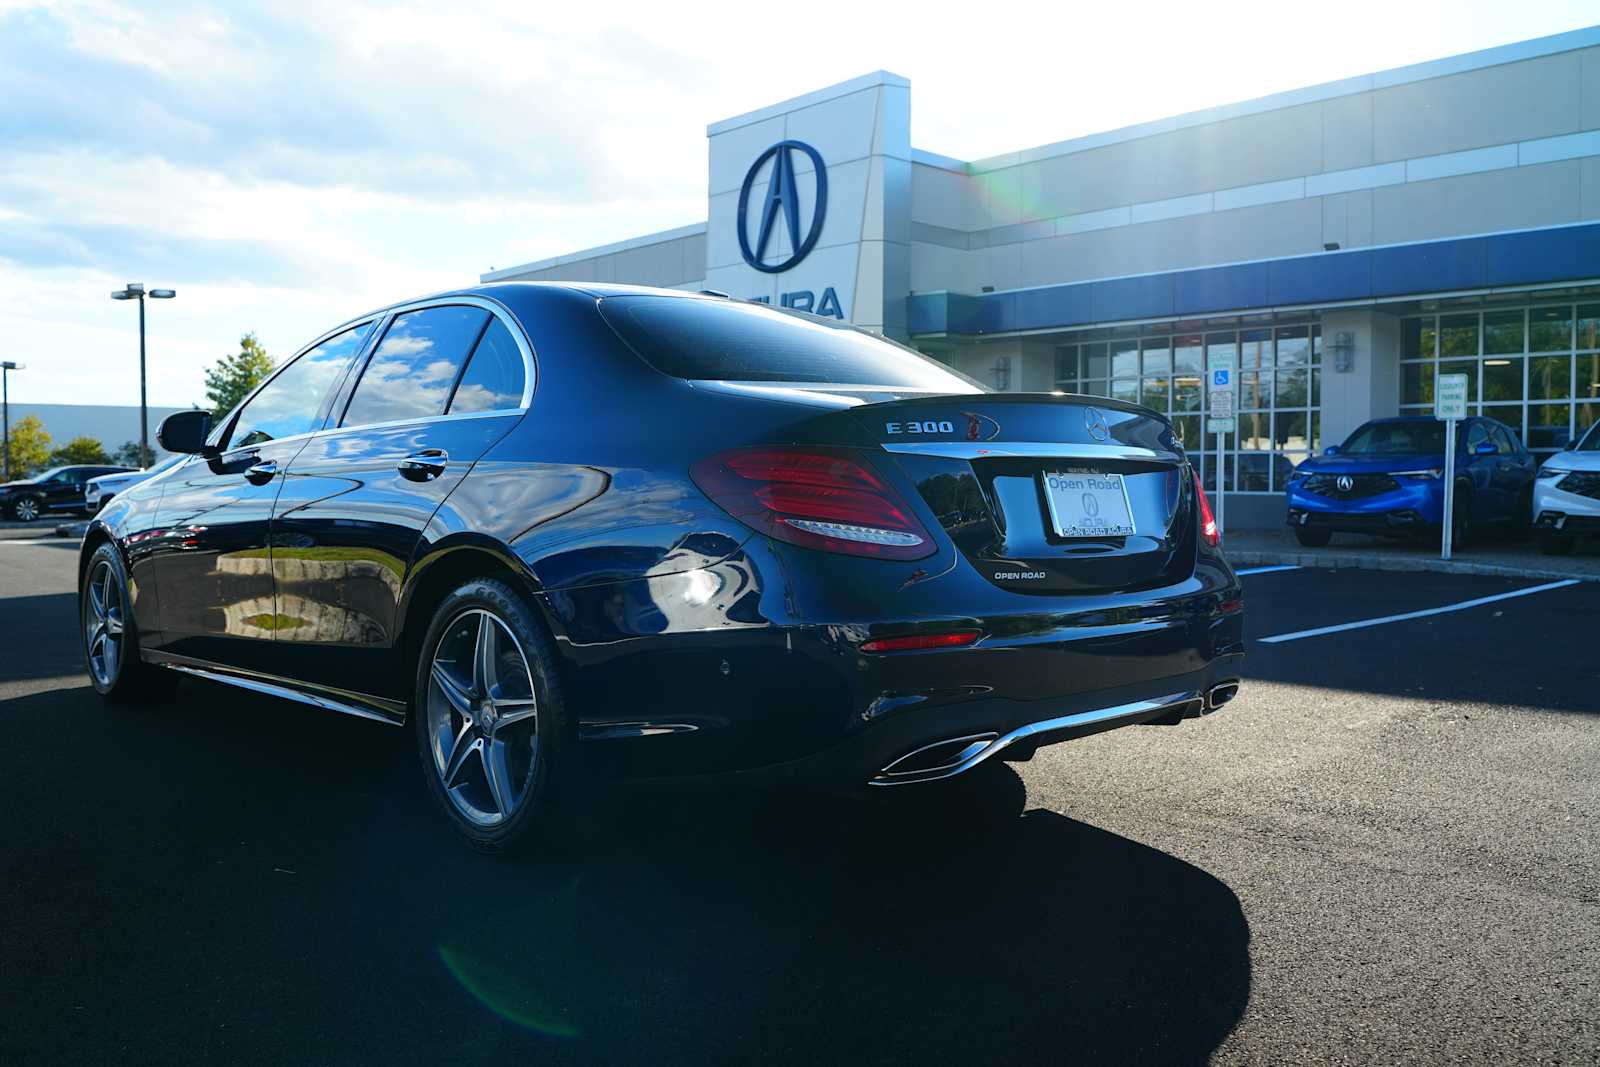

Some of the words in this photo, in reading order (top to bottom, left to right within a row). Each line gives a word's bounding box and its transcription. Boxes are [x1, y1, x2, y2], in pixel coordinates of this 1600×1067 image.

[886, 422, 903, 434] E
[906, 421, 954, 433] 300
[1049, 477, 1084, 491] Open
[1087, 478, 1120, 490] Road
[1063, 528, 1084, 536] OPEN
[1085, 528, 1106, 536] ROAD
[994, 572, 1020, 580] OPEN
[1021, 571, 1046, 579] ROAD
